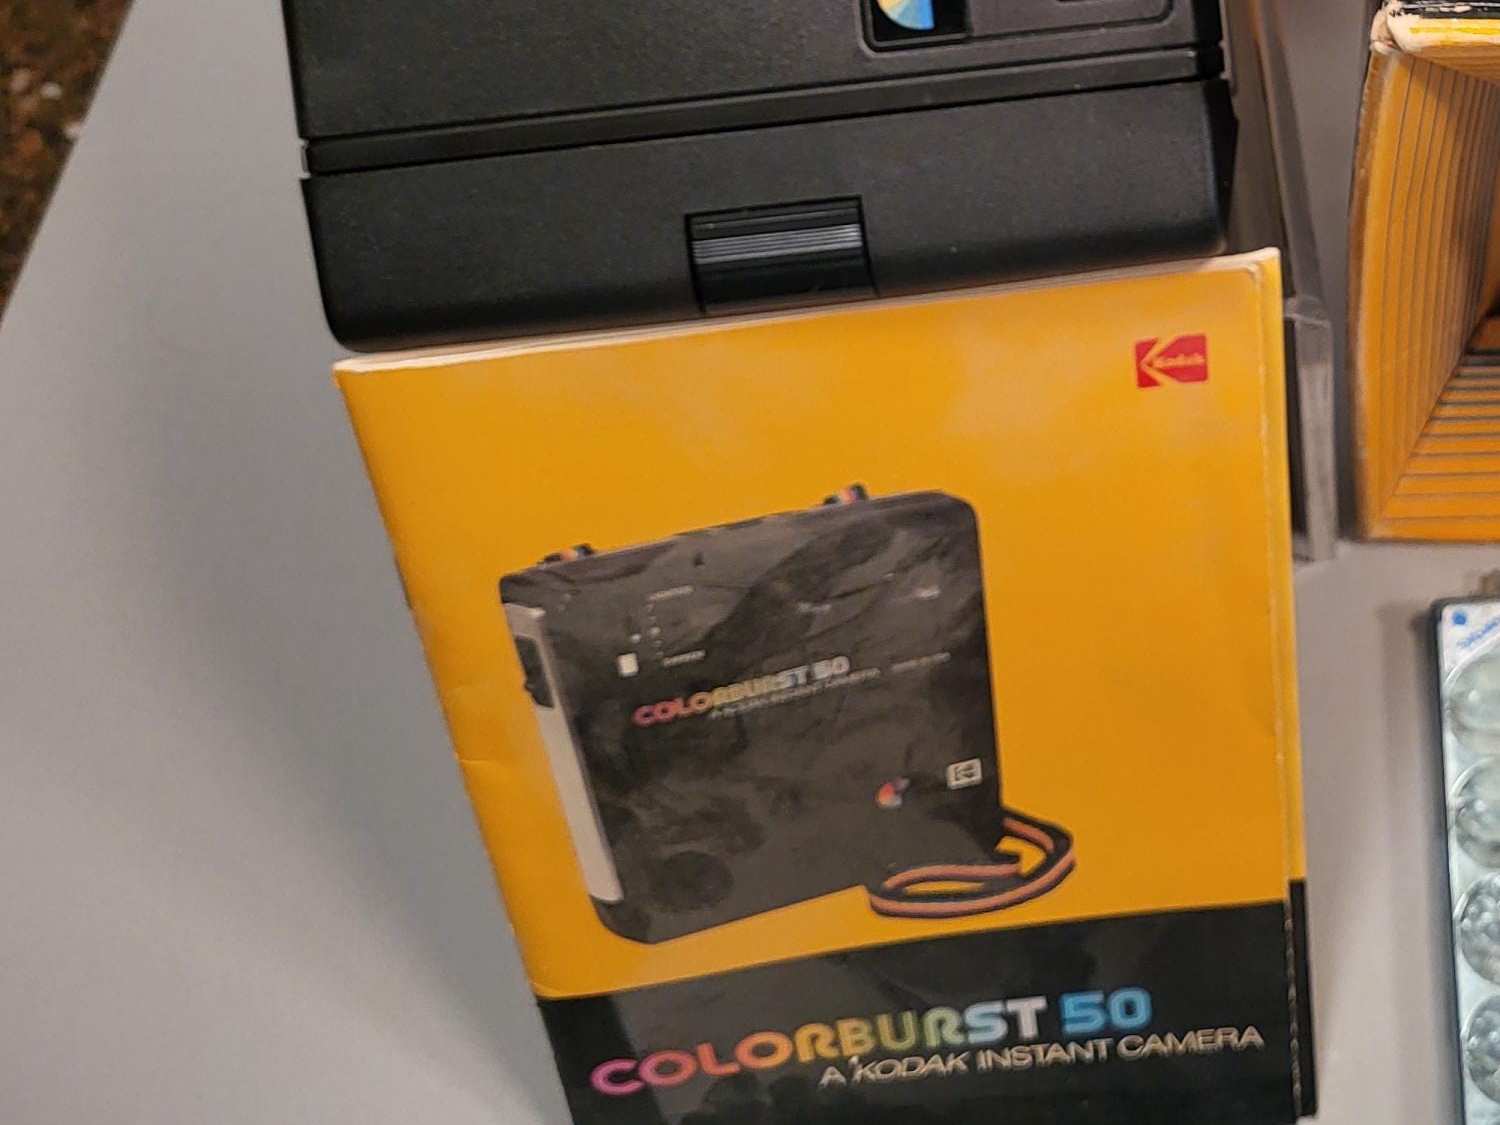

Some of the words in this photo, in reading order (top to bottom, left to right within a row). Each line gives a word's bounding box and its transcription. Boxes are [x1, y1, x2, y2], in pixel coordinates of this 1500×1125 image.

[590, 996, 1047, 1097] COLORBURST
[1060, 986, 1152, 1033] 50
[819, 1065, 846, 1088] A
[849, 1049, 969, 1085] KODAK
[976, 1036, 1114, 1070] INSTANT
[1116, 1023, 1266, 1061] CAMERA
